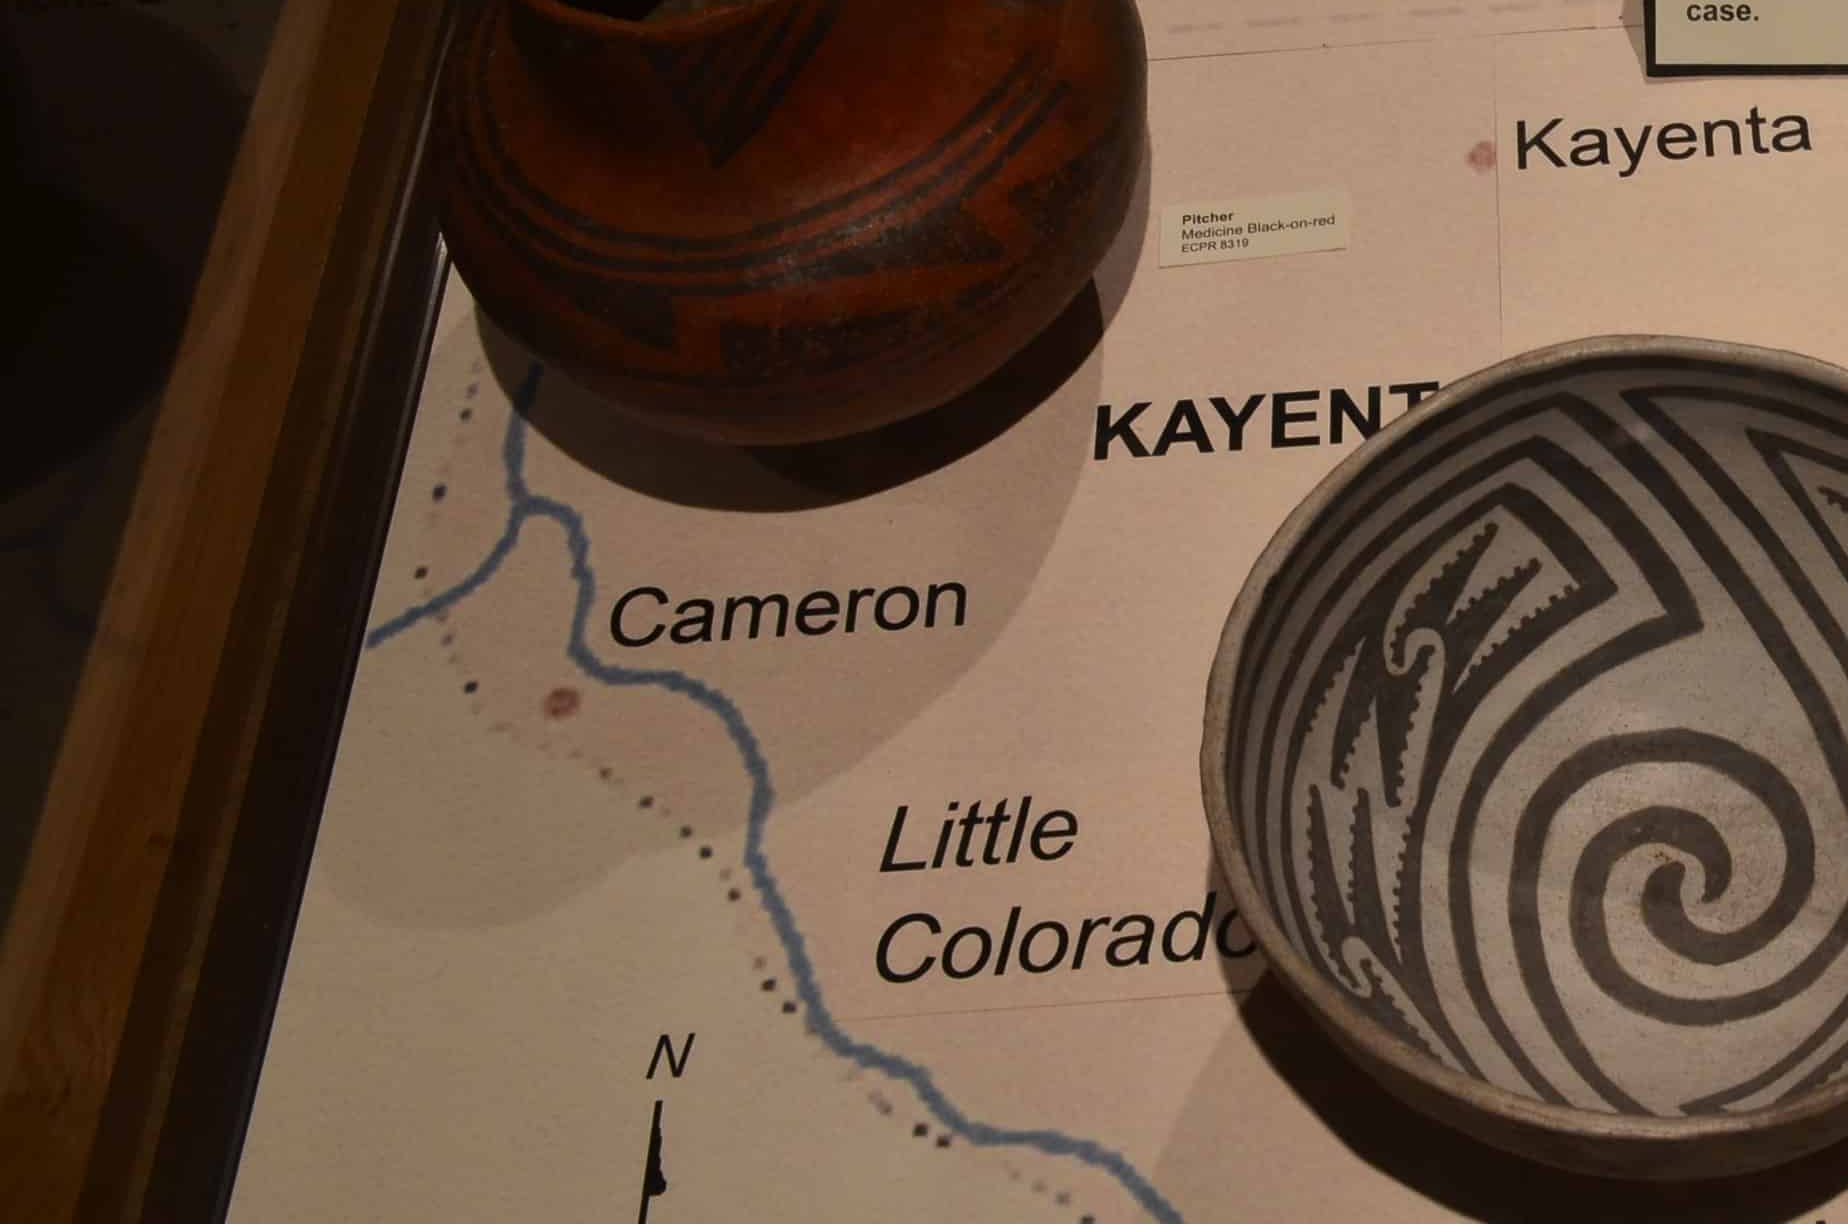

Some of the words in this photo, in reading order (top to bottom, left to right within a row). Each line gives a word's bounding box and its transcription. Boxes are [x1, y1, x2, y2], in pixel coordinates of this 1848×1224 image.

[1686, 2, 1760, 23] case.
[1515, 106, 1812, 178] Kayenta
[1181, 225, 1243, 240] Medicine
[1247, 214, 1336, 234] Black-on-red
[1181, 241, 1217, 253] ECPR
[1182, 212, 1234, 225] Pitcher
[1093, 381, 1440, 460] KAYENT
[609, 581, 967, 648] Cameron
[879, 795, 1079, 873] Little
[875, 891, 1258, 984] Colorado
[645, 1031, 697, 1081] N
